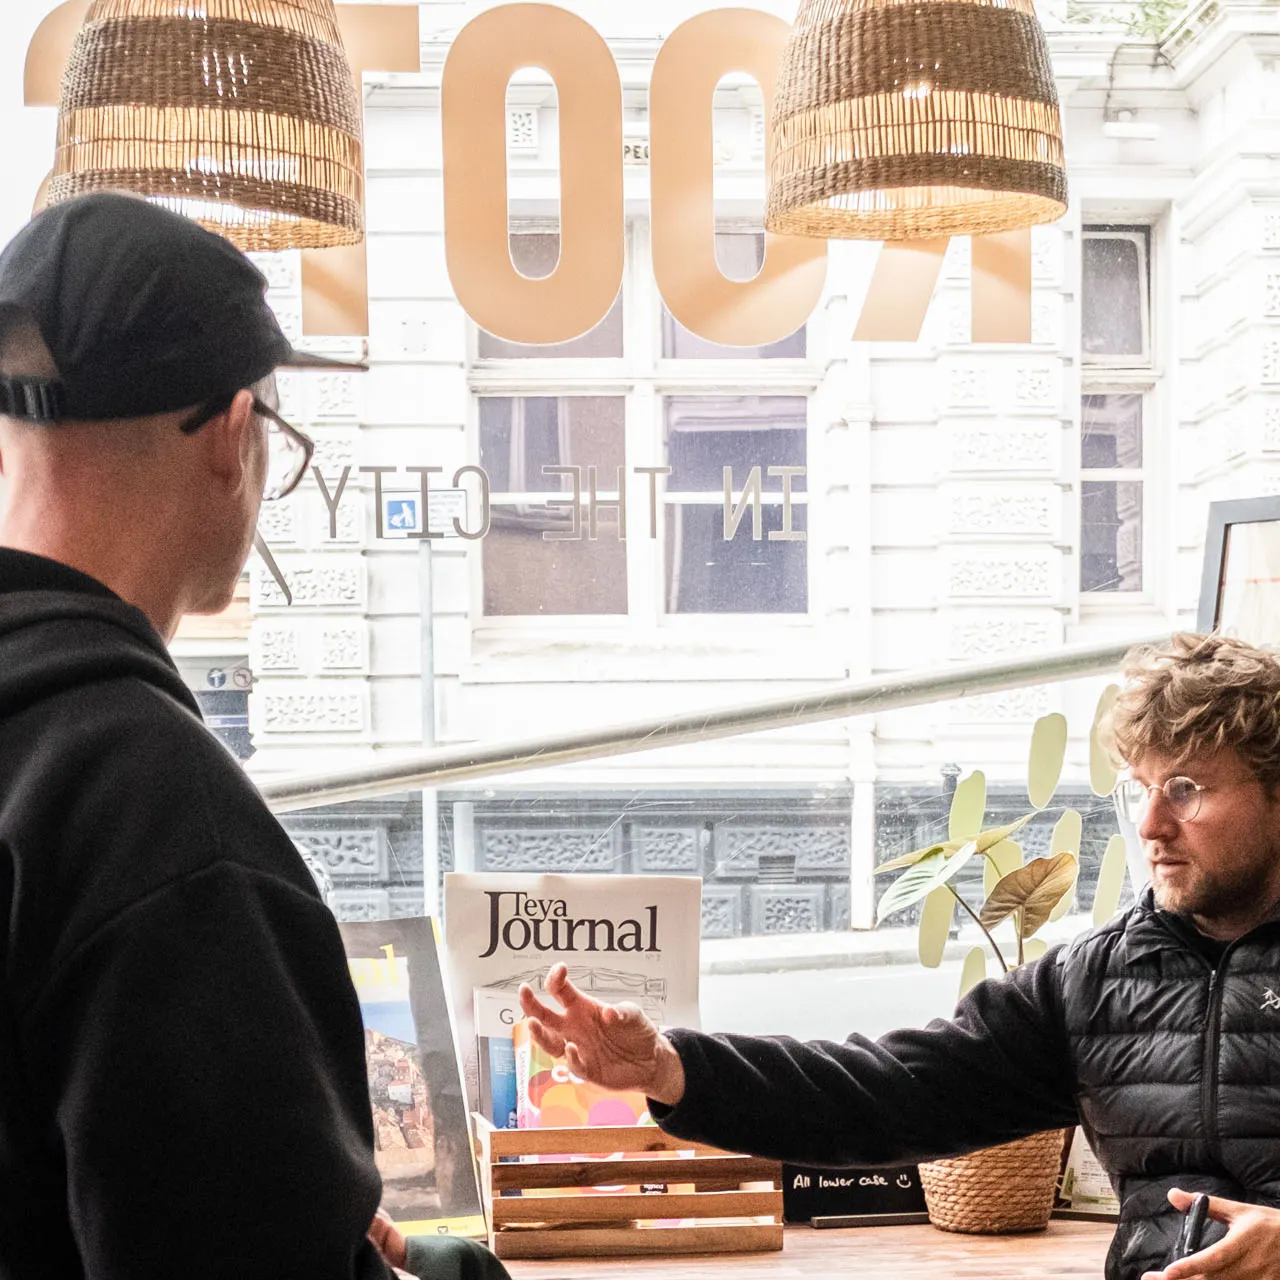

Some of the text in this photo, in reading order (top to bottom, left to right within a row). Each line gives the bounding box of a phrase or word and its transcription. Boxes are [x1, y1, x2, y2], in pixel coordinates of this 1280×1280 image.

[508, 891, 568, 922] Teya
[478, 891, 662, 958] Journal
[793, 1174, 888, 1189] All lower case
